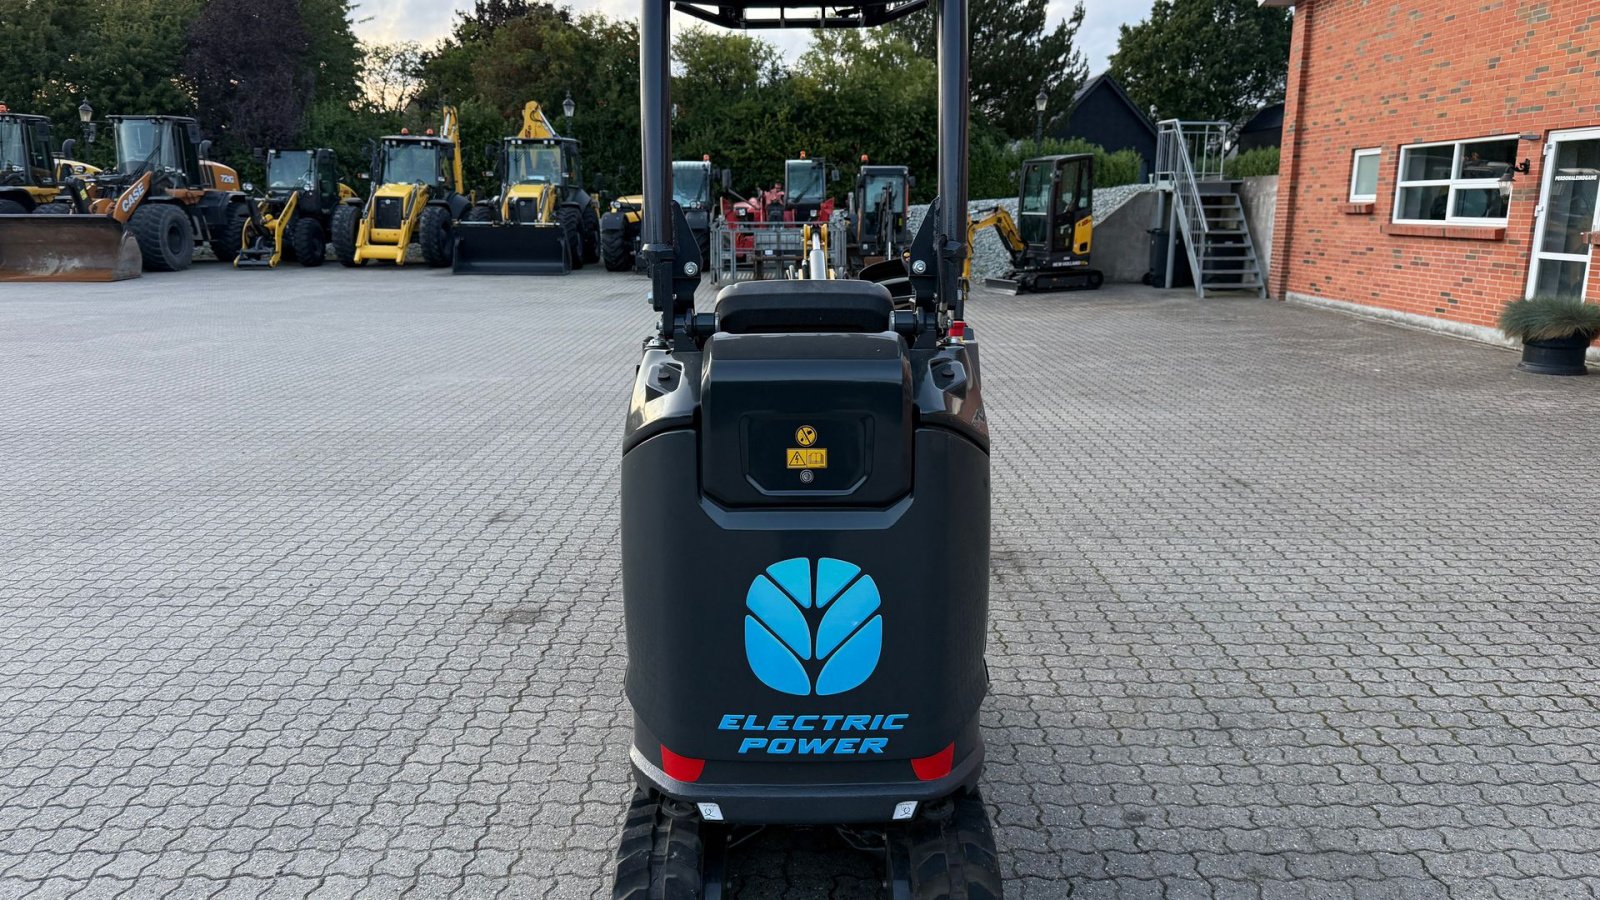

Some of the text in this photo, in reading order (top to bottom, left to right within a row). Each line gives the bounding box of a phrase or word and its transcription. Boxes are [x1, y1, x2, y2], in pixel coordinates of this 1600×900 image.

[121, 181, 145, 213] CASE
[718, 714, 909, 731] ELECTRIC
[738, 738, 888, 754] POWER
